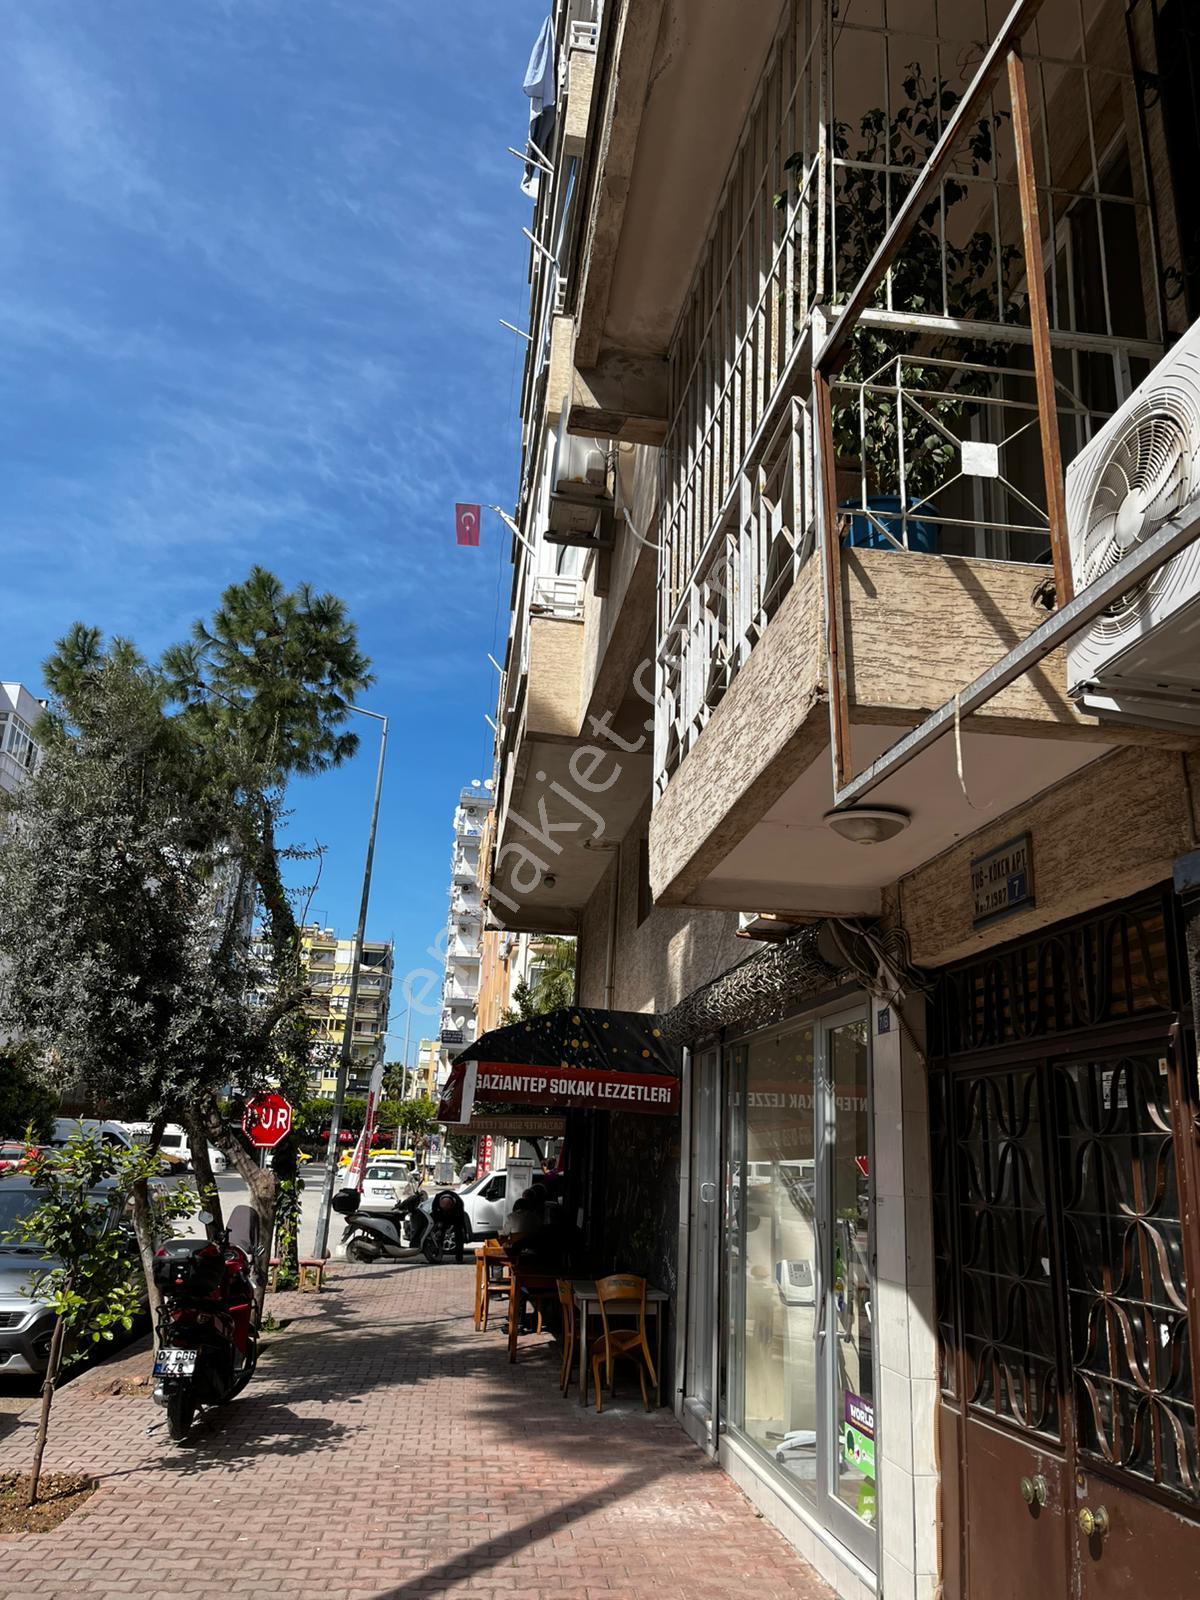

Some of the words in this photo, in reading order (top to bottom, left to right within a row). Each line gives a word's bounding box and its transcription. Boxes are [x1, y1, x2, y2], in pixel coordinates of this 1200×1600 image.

[549, 1079, 595, 1097] SOKAK
[158, 1350, 173, 1361] 07
[849, 1402, 874, 1429] WORLD
